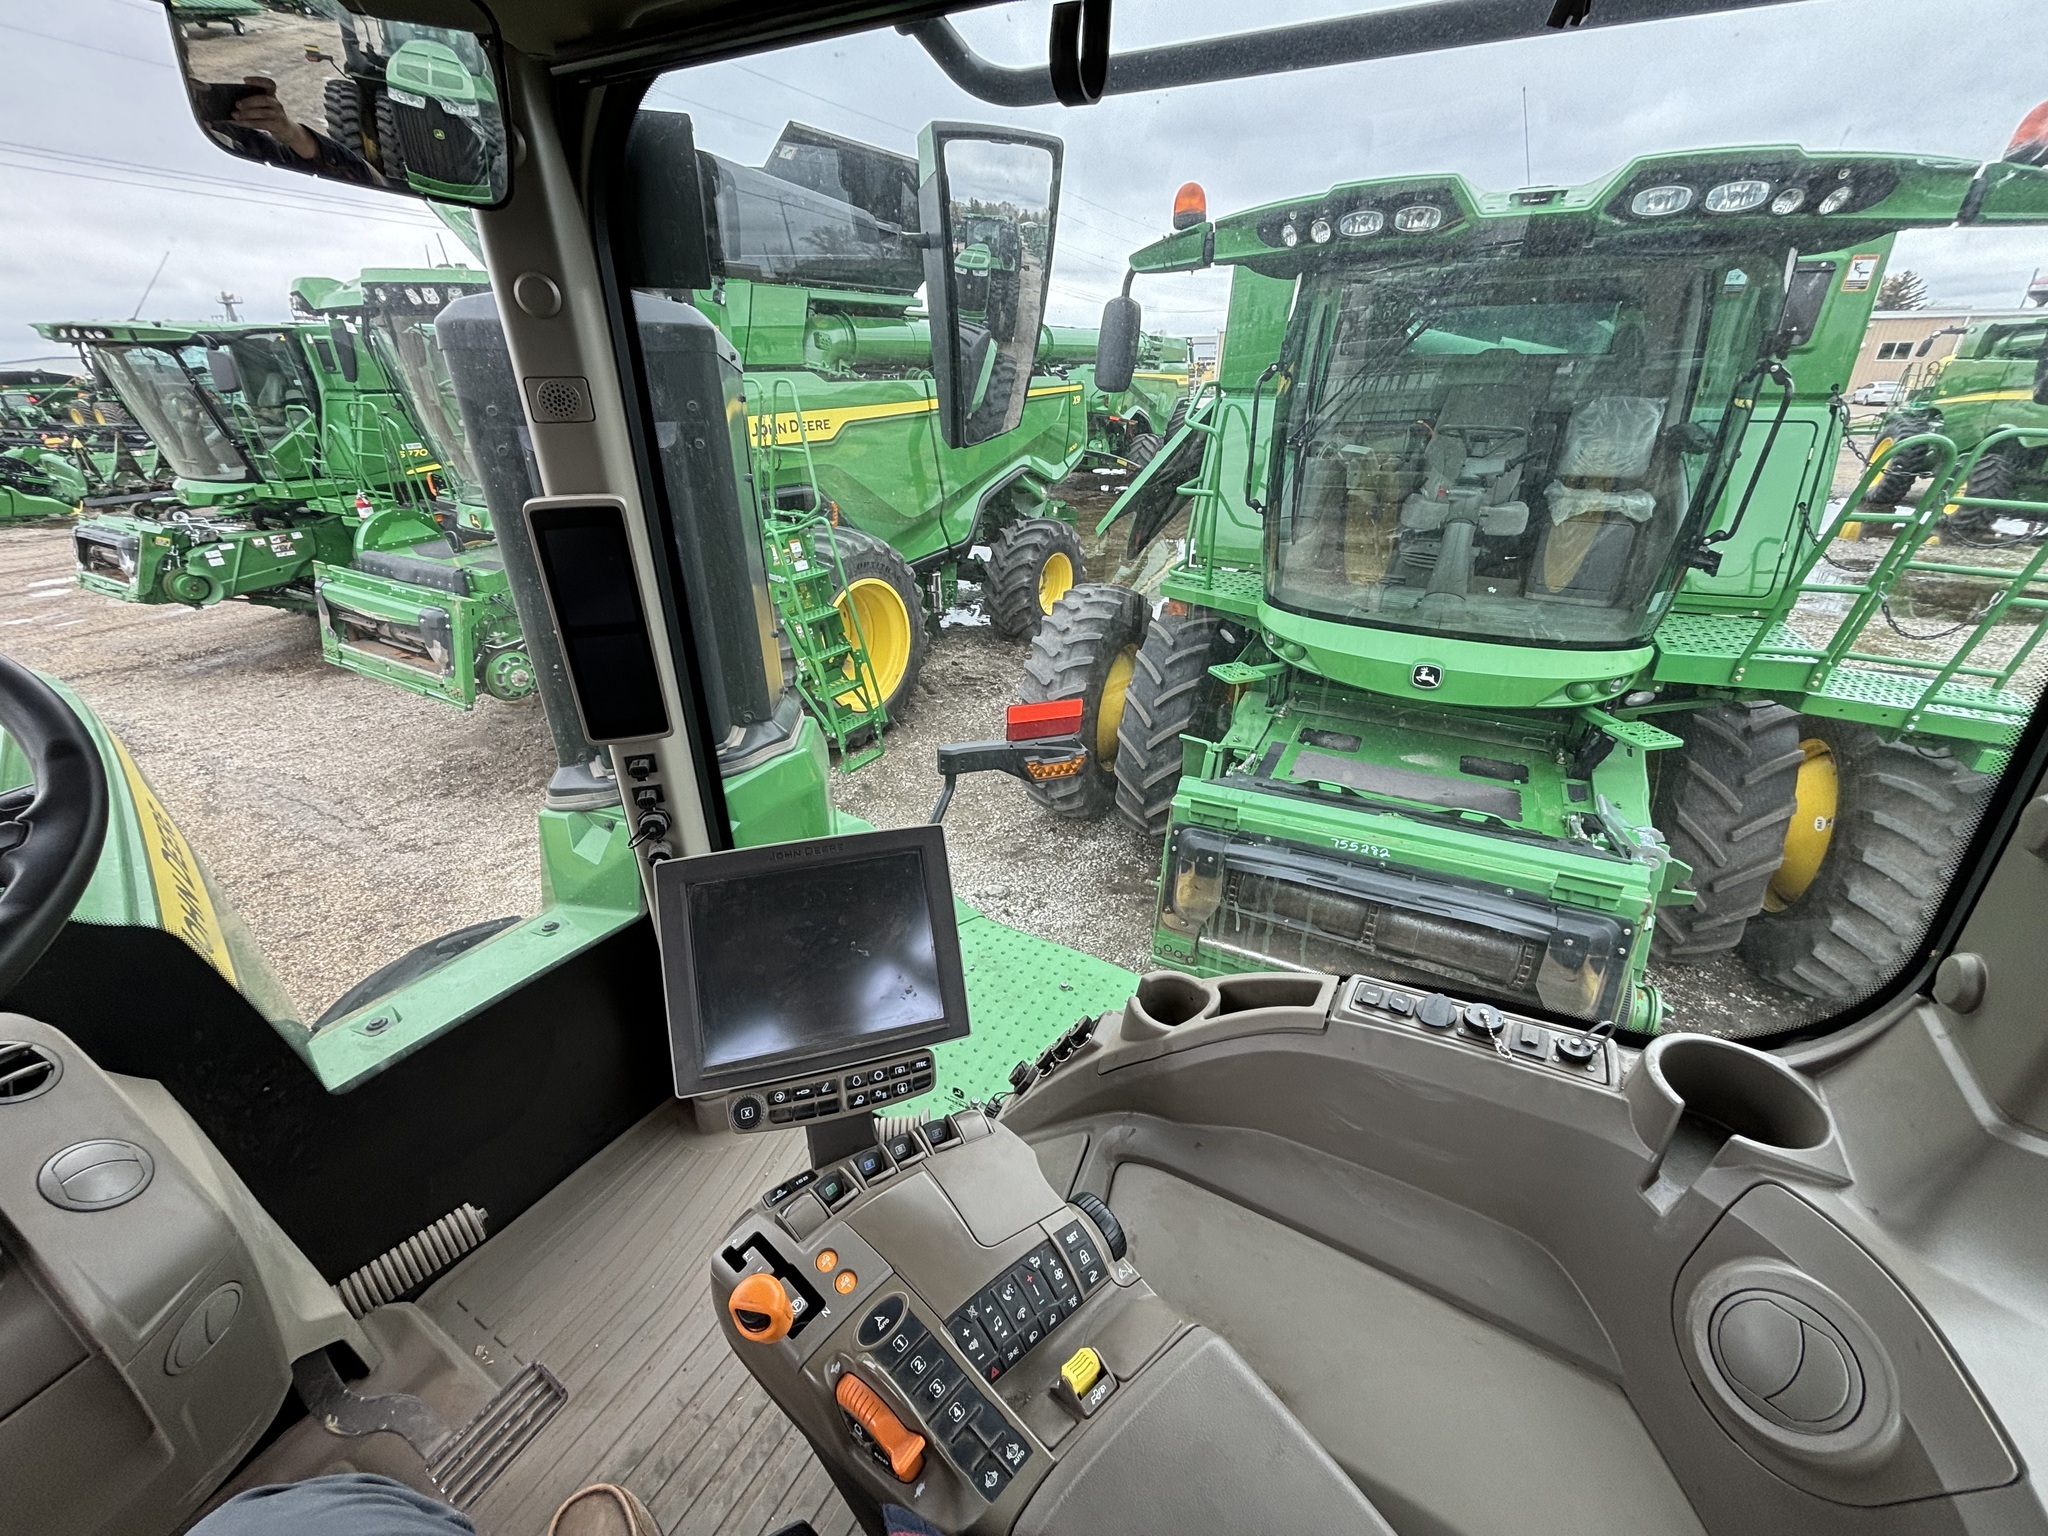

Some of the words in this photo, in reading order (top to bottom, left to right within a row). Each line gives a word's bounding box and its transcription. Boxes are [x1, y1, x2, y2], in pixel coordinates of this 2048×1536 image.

[1072, 395, 1081, 405] X9
[751, 423, 787, 437] JOHN
[789, 419, 831, 433] DEERE
[770, 849, 801, 860] JOHN
[804, 843, 844, 856] DEERE
[1330, 837, 1391, 858] 755282
[1066, 1231, 1079, 1244] SET
[821, 1306, 831, 1318] N
[878, 1318, 890, 1331] AUTO
[1013, 1450, 1025, 1466] AUTO
